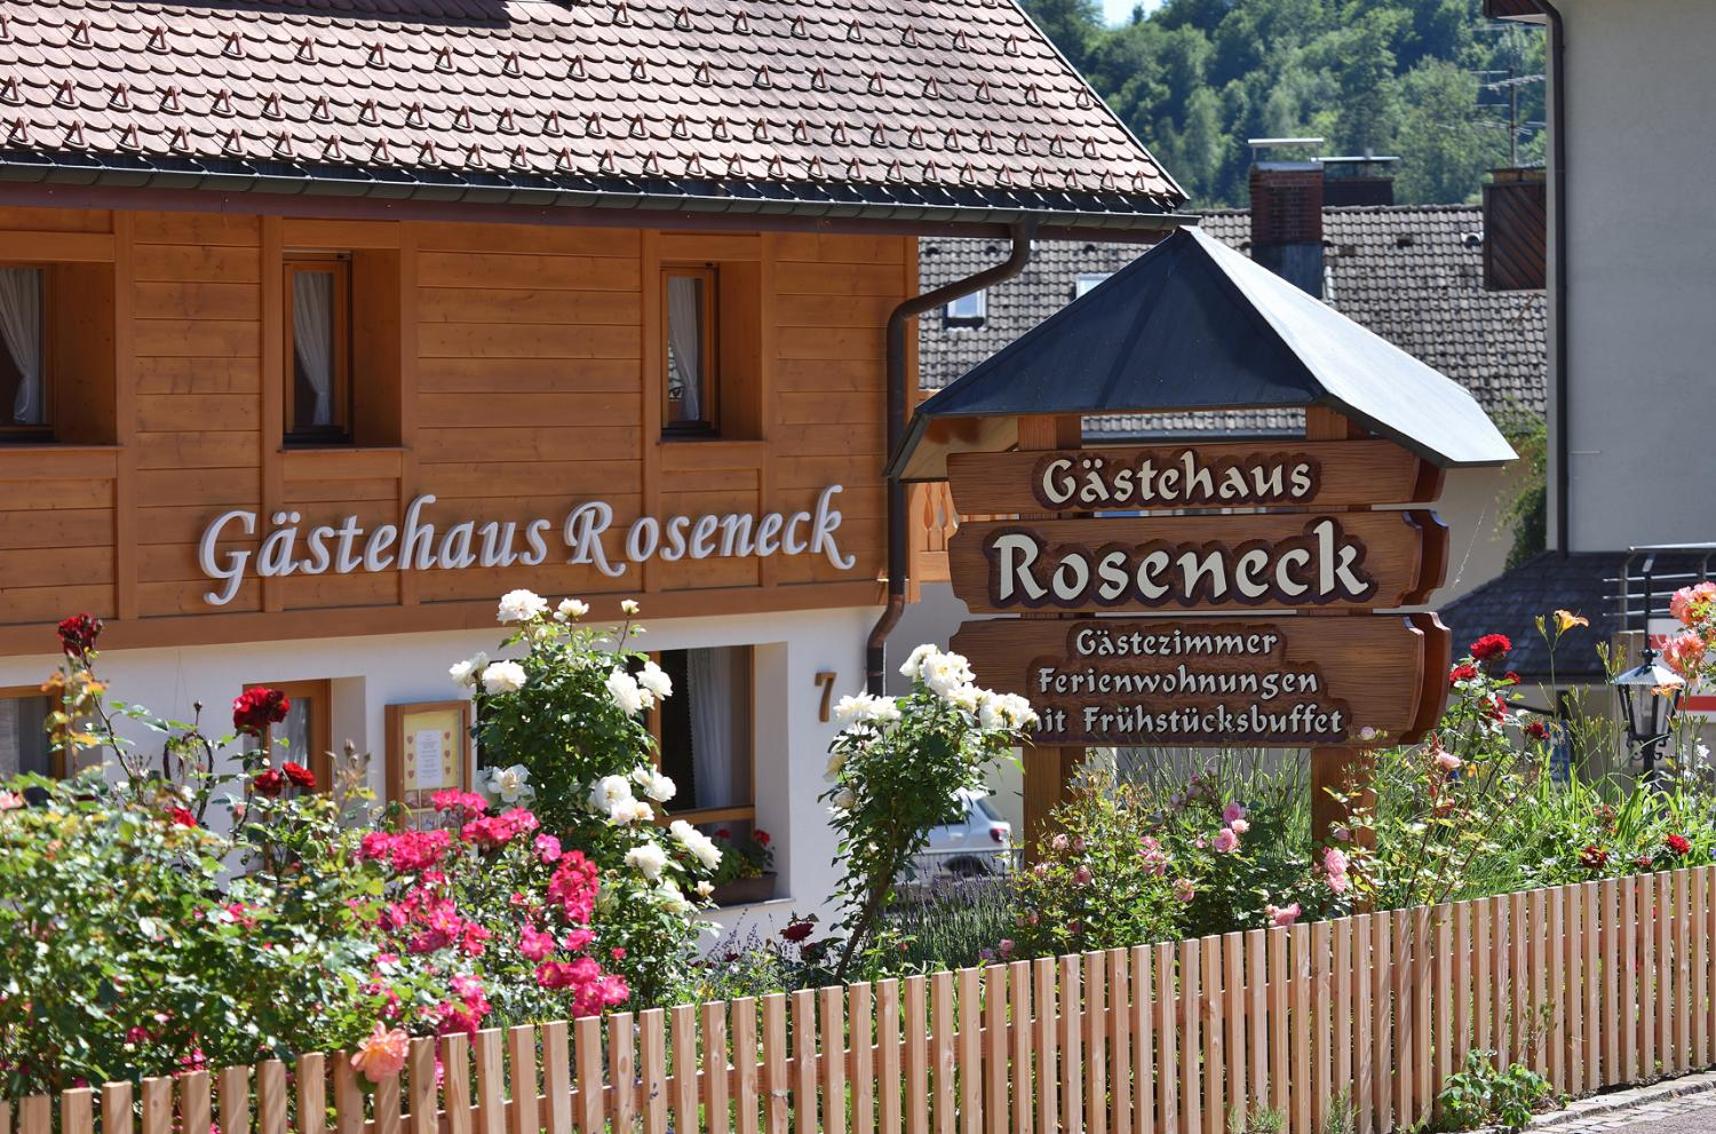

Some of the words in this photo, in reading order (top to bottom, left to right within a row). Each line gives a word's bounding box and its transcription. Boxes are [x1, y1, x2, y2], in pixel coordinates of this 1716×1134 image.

[1042, 451, 1311, 503] Gästehaus
[199, 494, 551, 606] Gästehaus
[564, 484, 856, 577] Roseneck
[993, 520, 1369, 600] Roseneck
[1076, 629, 1278, 655] Gästezimmer
[814, 672, 837, 723] 7
[1039, 666, 1318, 699] Ferienwohnungen
[1034, 707, 1066, 733] it
[1084, 704, 1342, 734] Frühstücksbuffet
